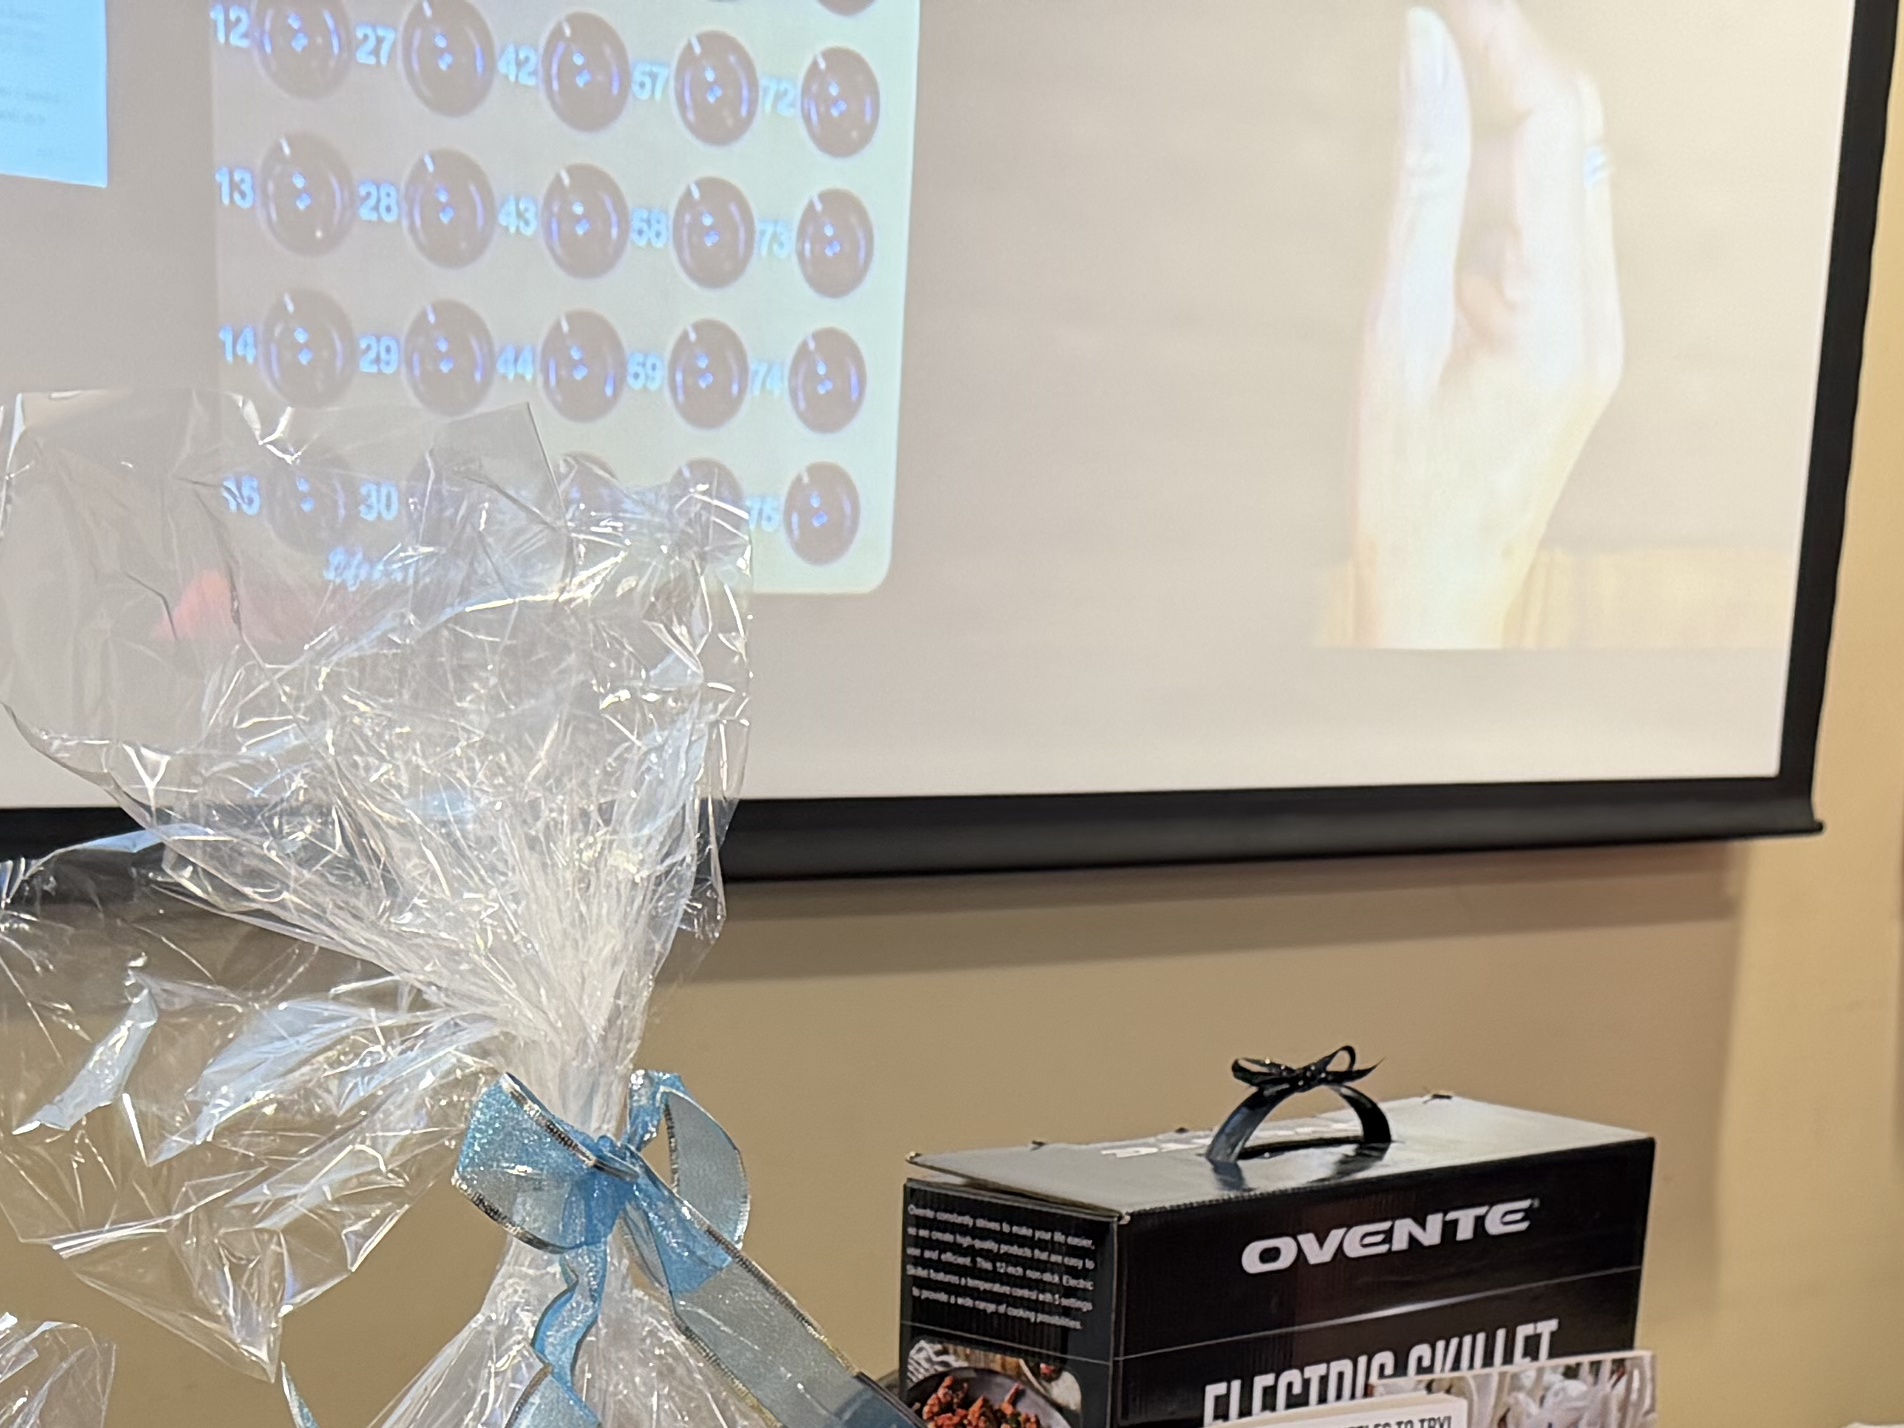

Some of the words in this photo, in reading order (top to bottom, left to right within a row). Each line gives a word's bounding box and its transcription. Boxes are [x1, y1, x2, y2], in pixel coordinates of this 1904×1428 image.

[210, 5, 253, 47] 12
[354, 26, 397, 68] 27
[498, 47, 540, 87] 42
[631, 62, 672, 101] 57
[762, 77, 796, 117] 72
[215, 168, 256, 206] 13
[357, 182, 400, 221] 28
[498, 199, 540, 237] 43
[631, 210, 671, 247] 58
[758, 221, 795, 260] 73
[219, 326, 258, 365] 14
[358, 335, 400, 375] 29
[498, 345, 537, 381] 44
[626, 352, 665, 389] 59
[751, 362, 786, 398] 74
[359, 481, 398, 522] 30
[1241, 1198, 1534, 1275] OVENTE
